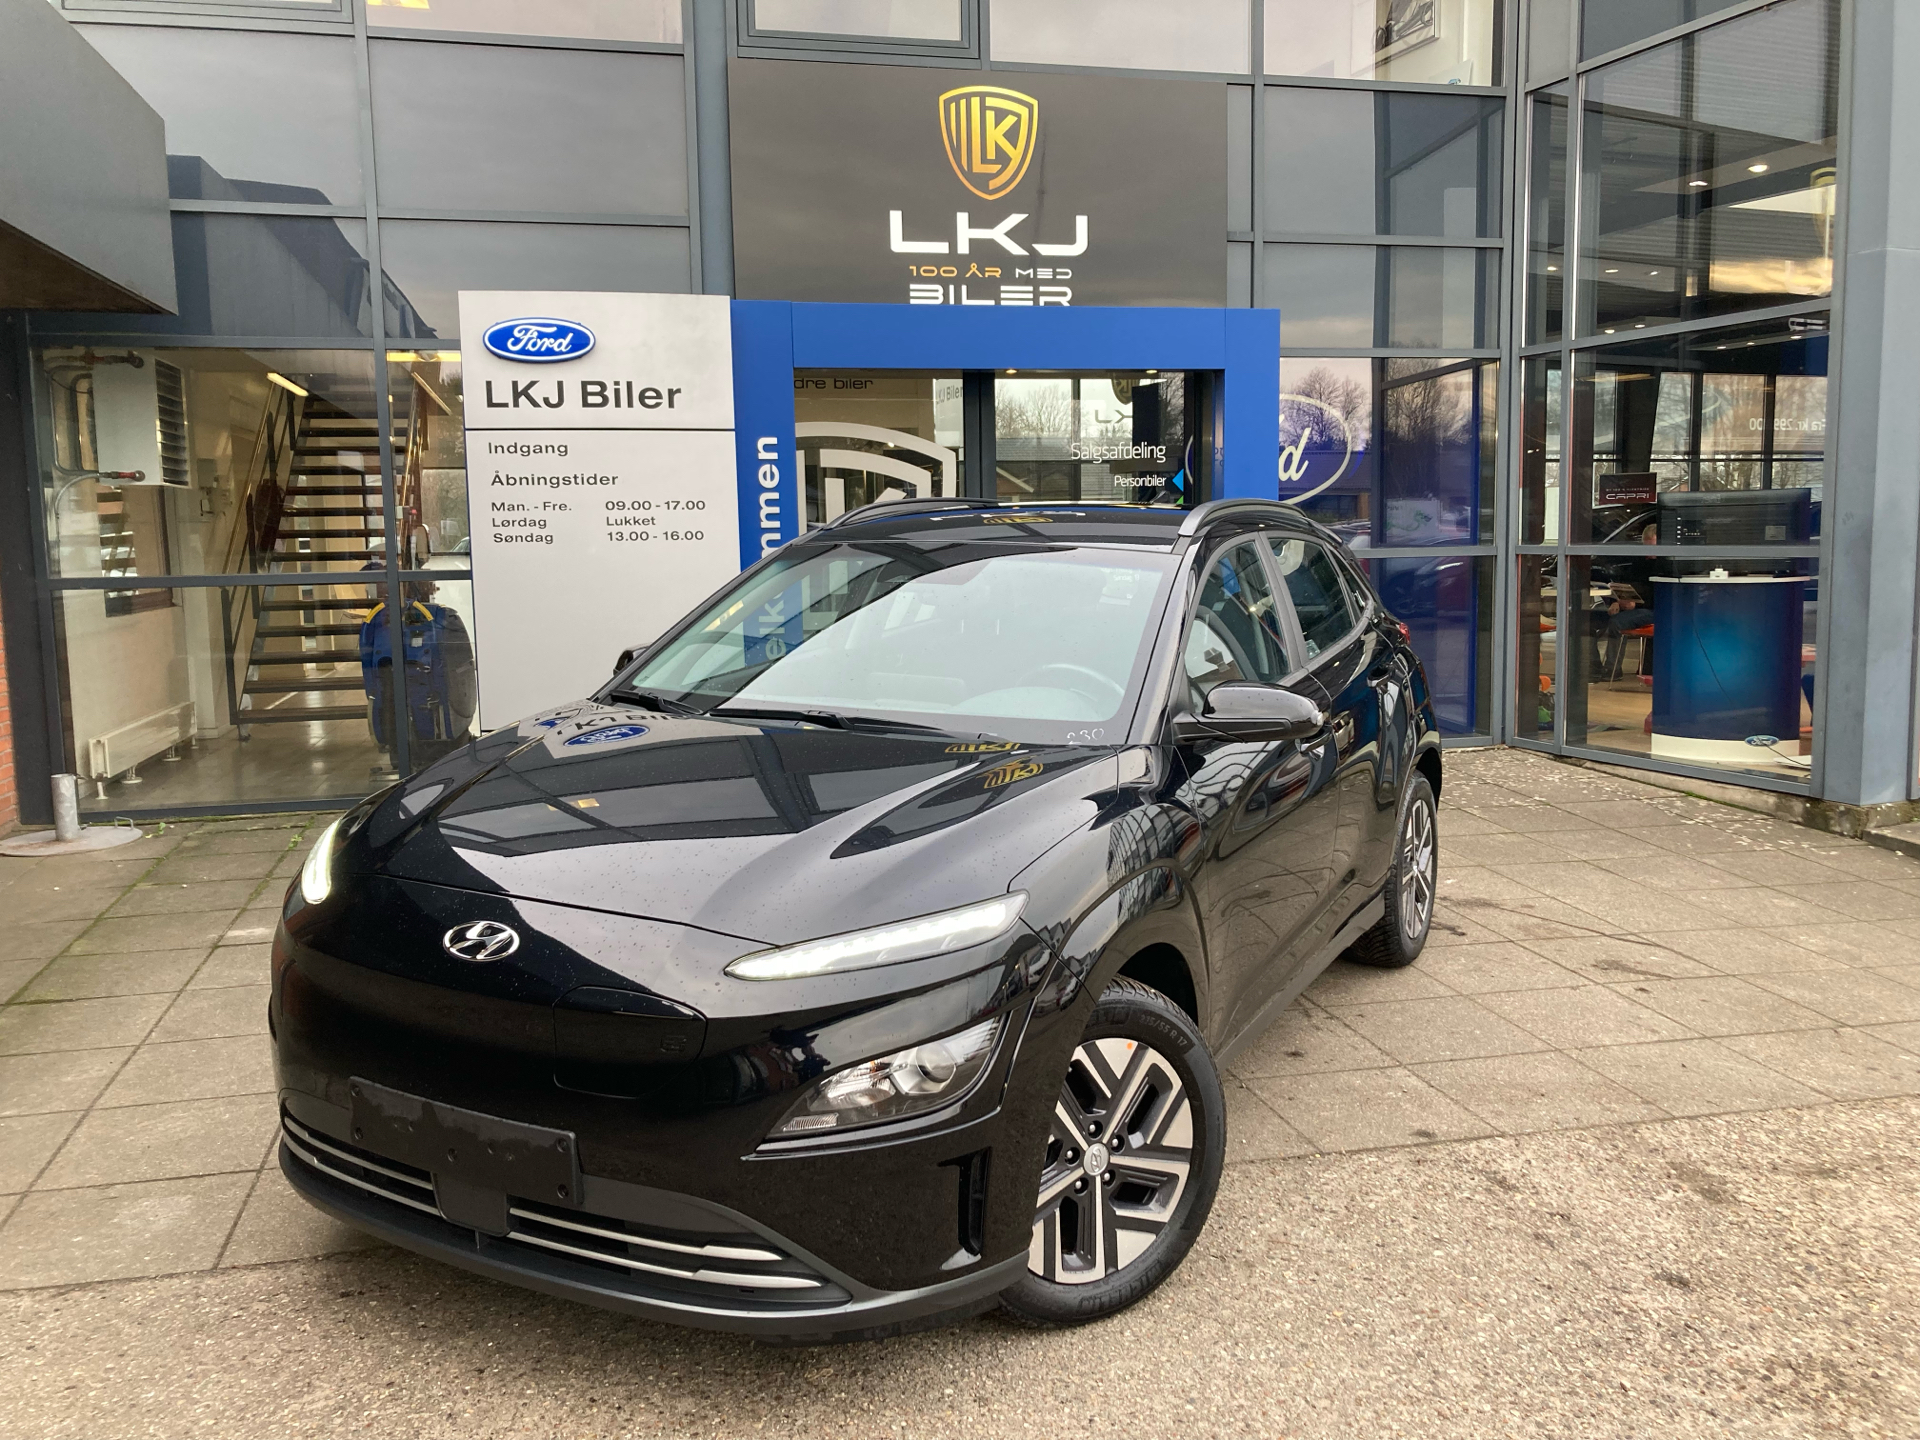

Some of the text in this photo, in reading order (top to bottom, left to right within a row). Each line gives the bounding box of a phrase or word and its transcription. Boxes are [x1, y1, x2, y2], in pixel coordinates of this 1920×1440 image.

[889, 209, 1089, 256] LKJ
[909, 262, 1073, 279] 100 ÅR MED
[909, 283, 1073, 307] BILER
[833, 377, 874, 390] biler
[485, 379, 682, 410] LKJ Biler
[488, 441, 569, 457] Indgang
[1071, 441, 1167, 464] Salgsafdeling
[490, 469, 619, 488] Åbningstider
[1114, 474, 1167, 487] Personbiler
[1605, 492, 1650, 500] CAPRI
[491, 501, 530, 512] Man.
[542, 501, 573, 512] Fre.
[492, 515, 656, 529] Lørdag Lukket
[493, 532, 554, 545] Søndag
[607, 530, 650, 542] 13.00
[662, 530, 705, 542] 16.00
